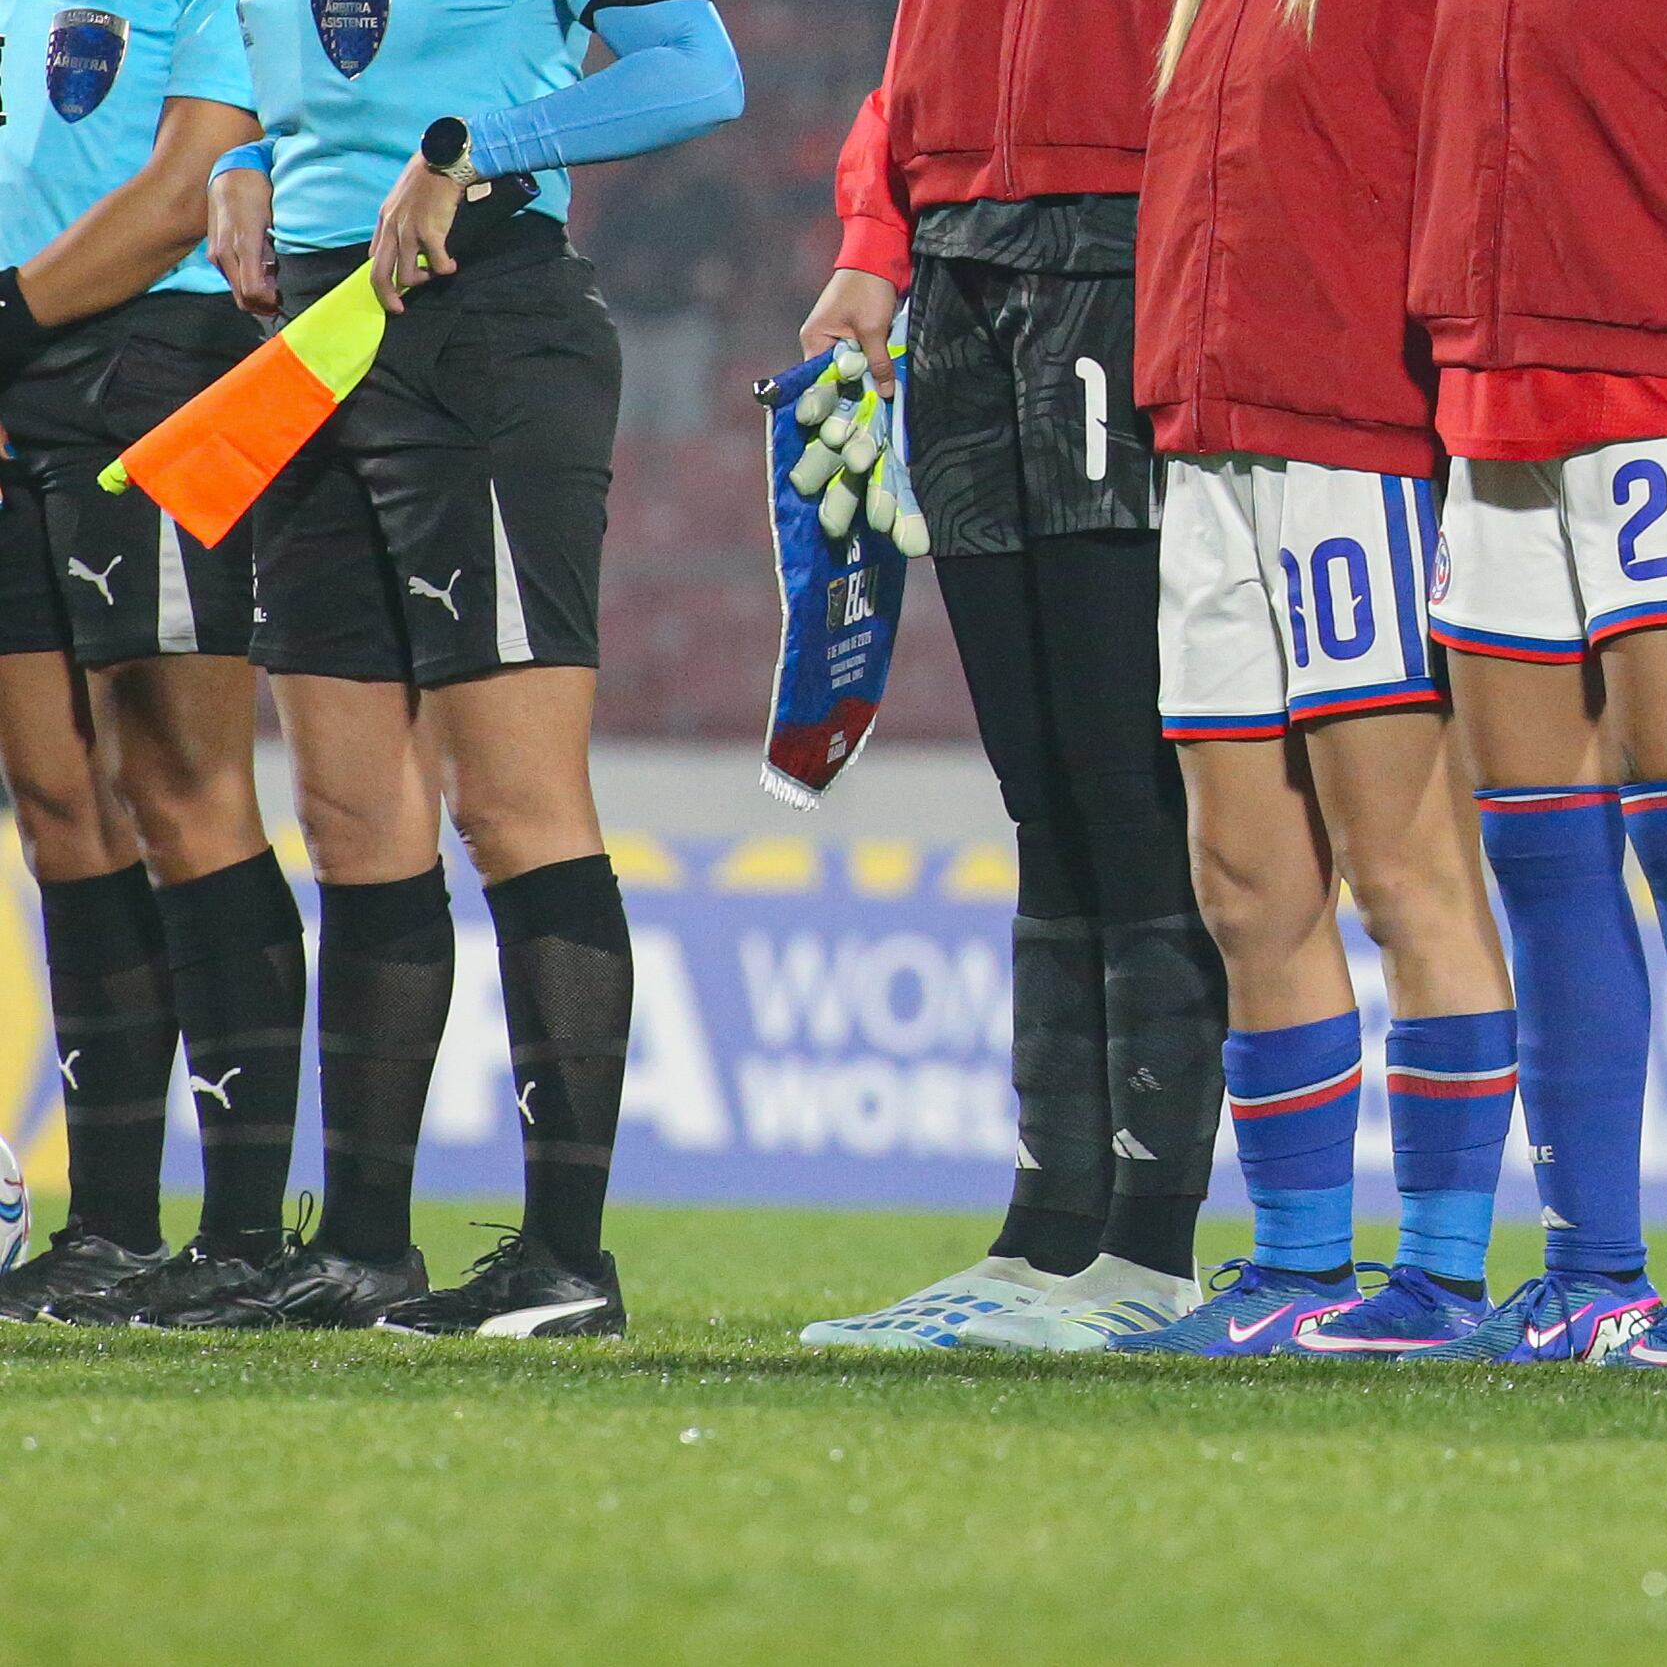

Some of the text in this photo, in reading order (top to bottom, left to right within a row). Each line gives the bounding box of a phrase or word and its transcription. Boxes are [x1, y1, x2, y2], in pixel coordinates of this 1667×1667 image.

[321, 17, 378, 29] ASISTENTE
[1075, 356, 1107, 481] 1
[1281, 537, 1376, 668] 10
[738, 1054, 1020, 1156] WORL
